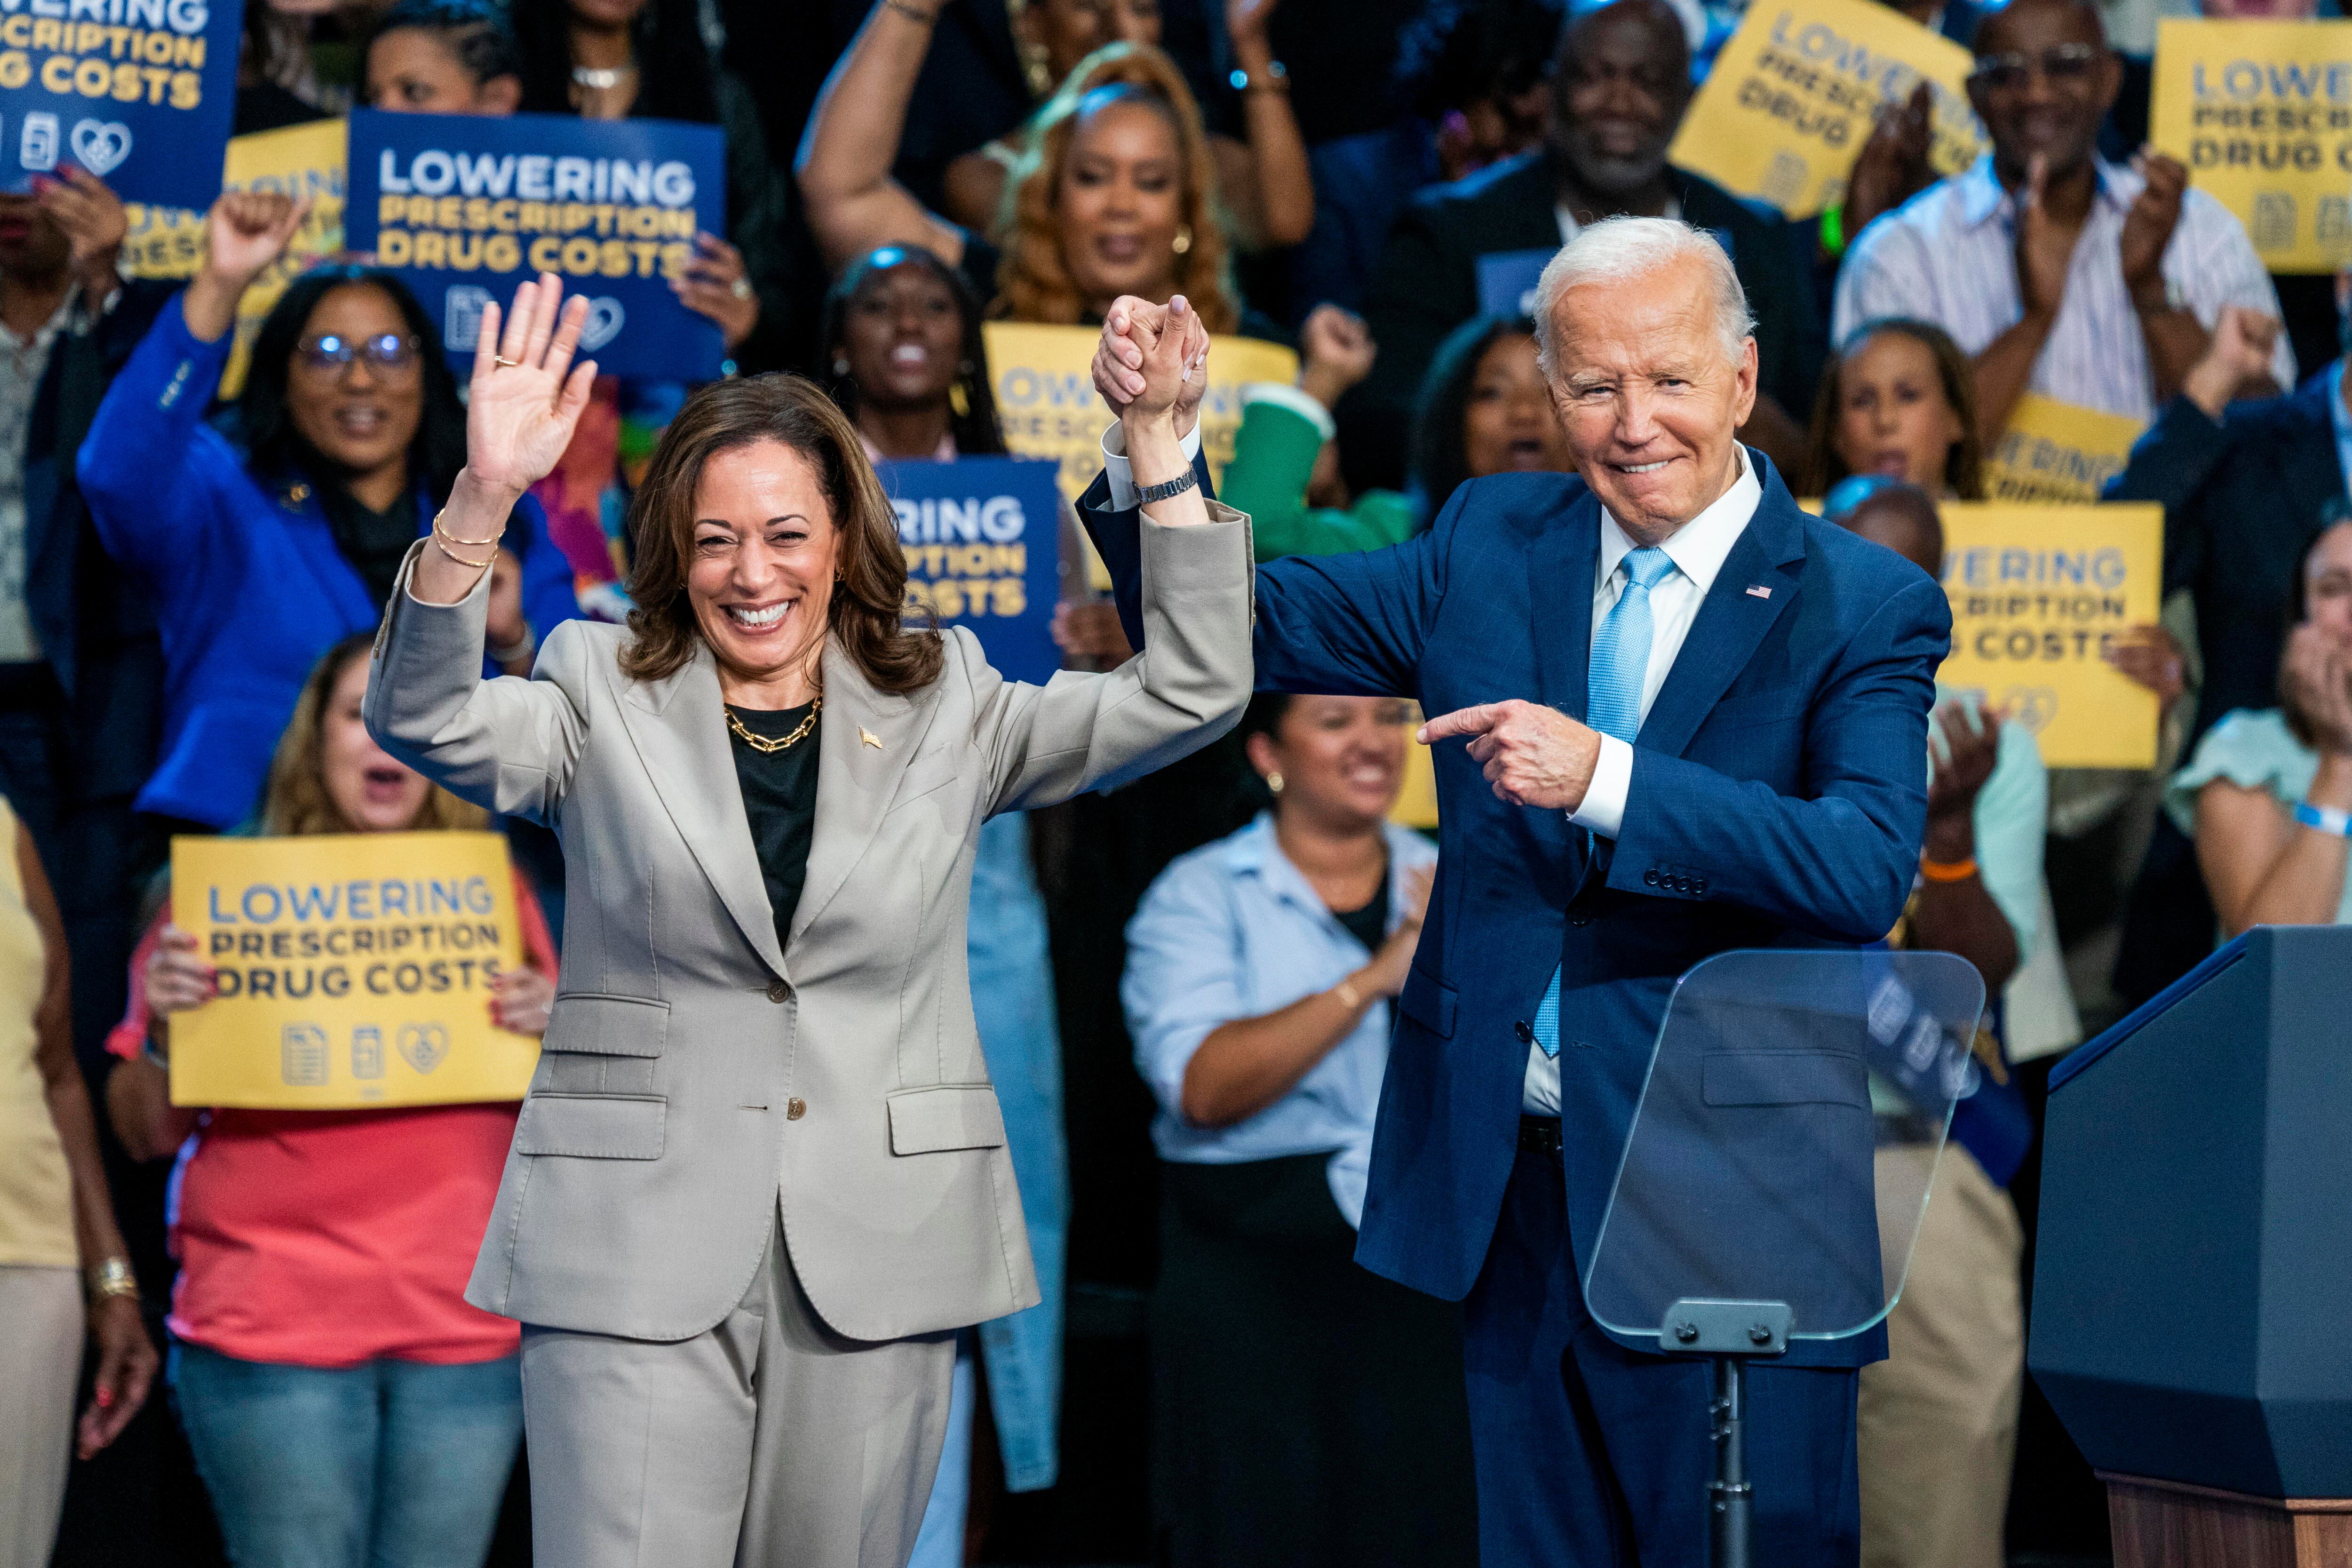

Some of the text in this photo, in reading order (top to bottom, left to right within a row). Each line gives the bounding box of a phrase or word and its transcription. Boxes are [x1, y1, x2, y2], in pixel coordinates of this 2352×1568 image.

[0, 13, 206, 69] CRIPTION
[41, 55, 202, 110] COSTS
[379, 148, 695, 206] LOWERING
[379, 194, 696, 238] PRESCRIPTION
[378, 230, 689, 279] DRUG COSTS
[1942, 546, 2126, 590] ERING
[208, 876, 495, 925] LOWERING
[209, 922, 501, 959] PRESCRIPTION
[213, 956, 502, 1000] DRUG COSTS
